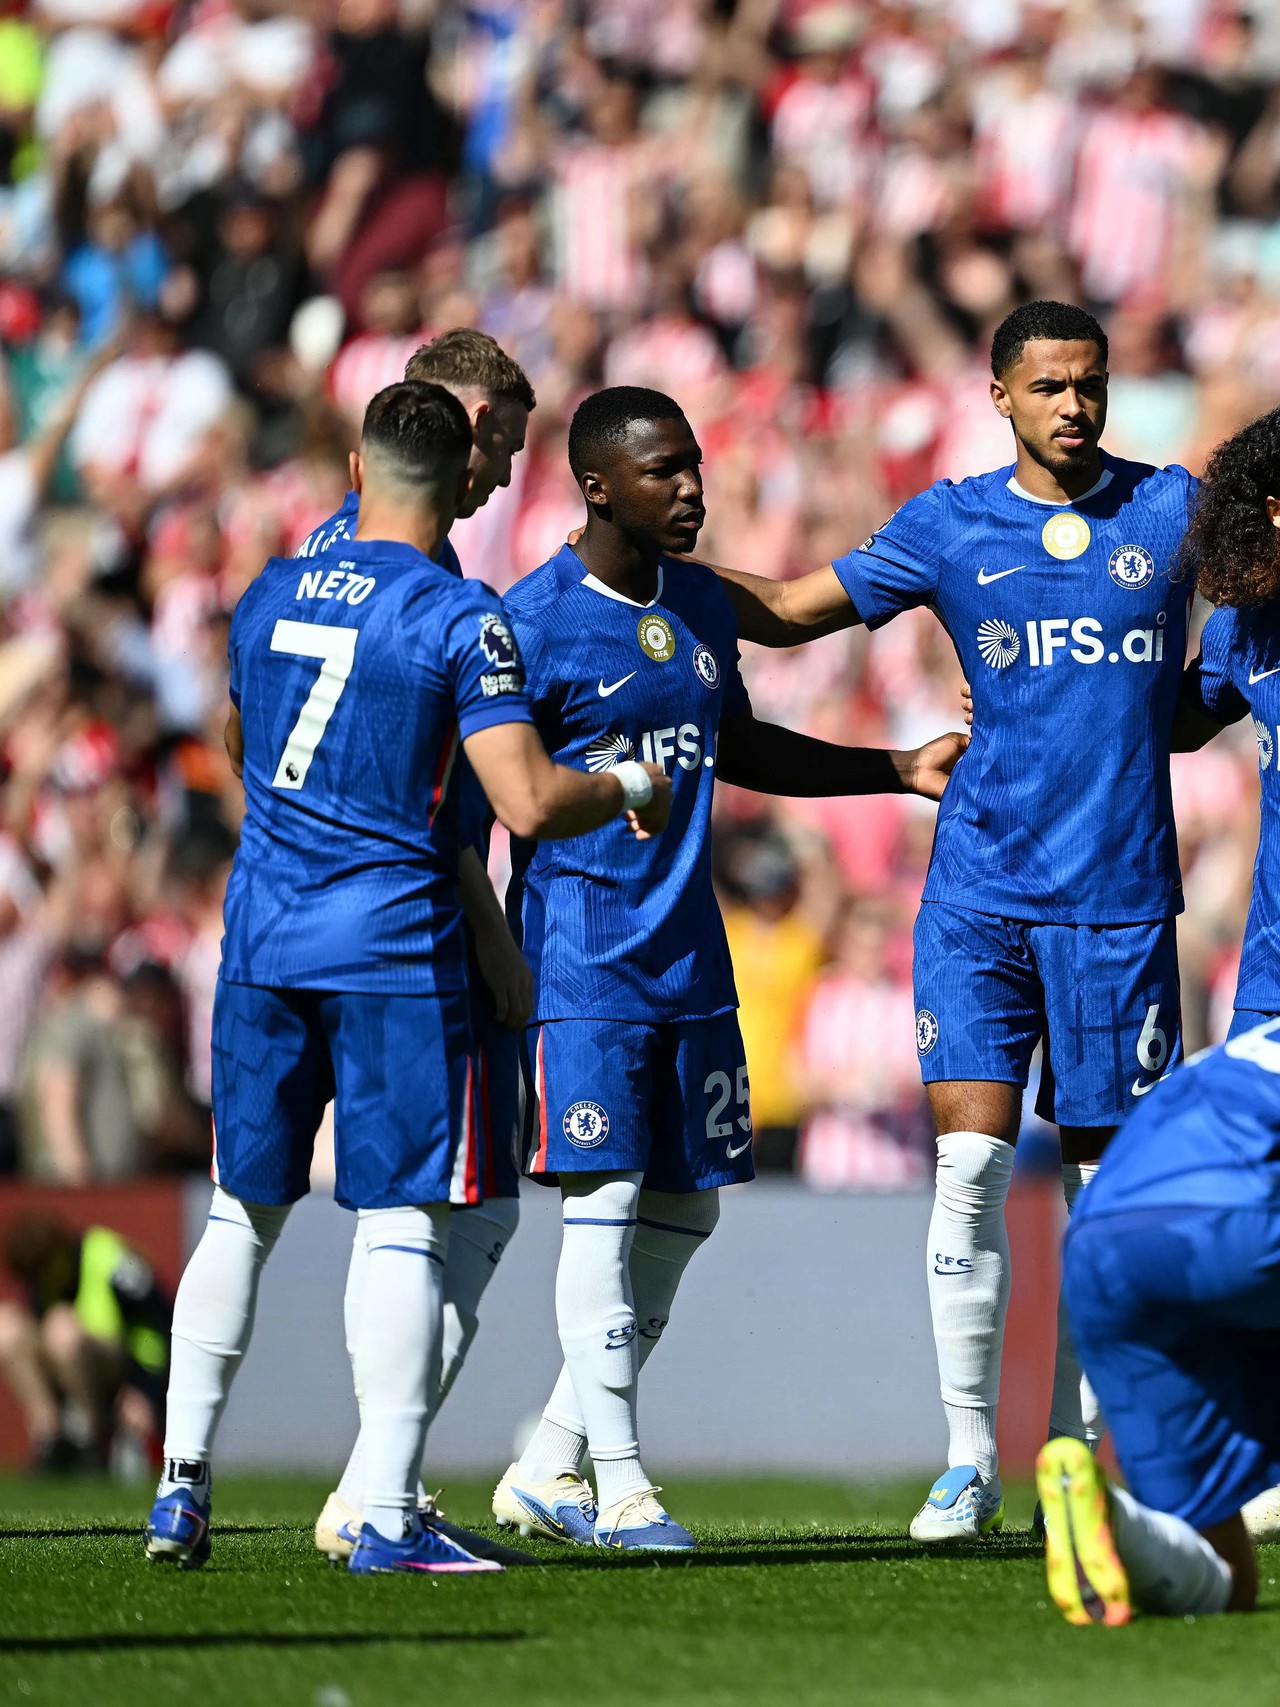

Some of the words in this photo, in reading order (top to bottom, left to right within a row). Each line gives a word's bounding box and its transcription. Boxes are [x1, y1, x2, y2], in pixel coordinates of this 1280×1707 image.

[1116, 546, 1145, 556] CHELSEA
[296, 570, 376, 606] NETO
[646, 618, 672, 641] CHAMPIONS
[1026, 611, 1167, 667] IFS.ai
[653, 650, 669, 658] FIFA
[270, 619, 359, 790] 7
[642, 723, 718, 775] IFS.
[1137, 1004, 1167, 1071] 6
[570, 1103, 600, 1113] CHELSEA
[704, 1065, 752, 1139] 25
[936, 1253, 972, 1268] CFC
[648, 1318, 668, 1329] CF
